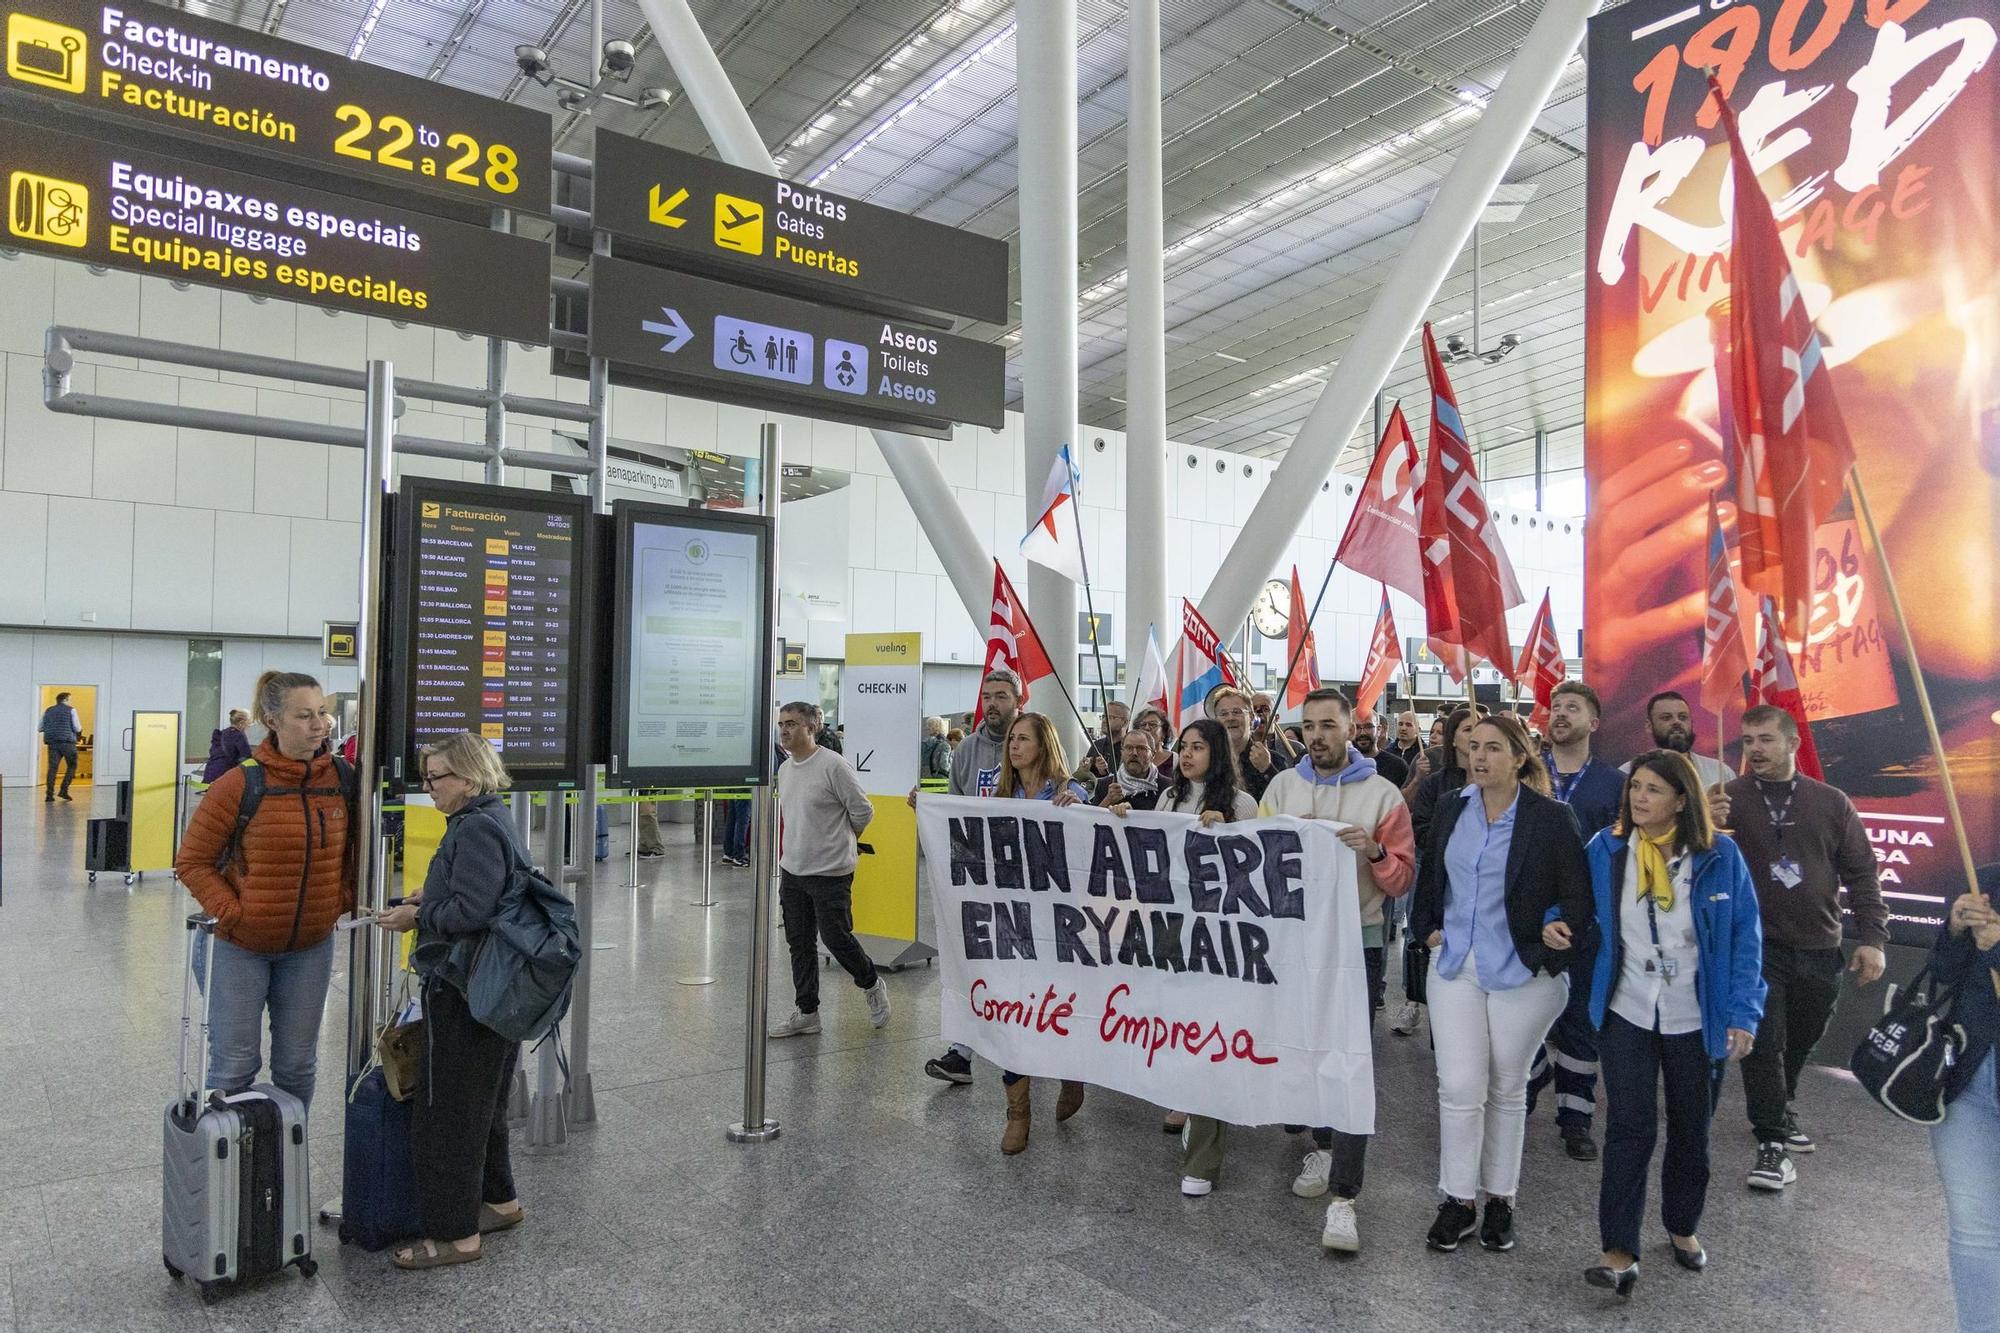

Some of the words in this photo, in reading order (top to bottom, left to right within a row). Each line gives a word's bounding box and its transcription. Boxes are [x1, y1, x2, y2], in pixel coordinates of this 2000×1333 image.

[101, 6, 330, 92] Facturamento
[102, 41, 211, 91] Check-in
[1633, 0, 1930, 146] 190
[101, 71, 296, 142] Facturación
[334, 105, 413, 171] 22
[418, 124, 440, 148] to
[1597, 17, 1998, 286] RED
[420, 157, 437, 177] a
[445, 133, 519, 194] 28
[112, 162, 279, 222] Equipaxes
[286, 204, 421, 252] especiais
[777, 182, 847, 222] Portas
[112, 196, 204, 236] Special
[211, 219, 307, 257] luggage
[777, 212, 824, 240] Gates
[1640, 164, 1933, 314] VINAGE
[110, 225, 269, 280] Equipajes
[276, 263, 428, 309] especiales
[776, 236, 859, 277] Puertas
[880, 325, 938, 356] Aseos
[881, 351, 929, 376] Toilets
[878, 376, 936, 405] Aseos
[607, 465, 675, 490] aenaparking.com
[445, 508, 507, 522] Facturación
[536, 532, 572, 541] Mostradores
[875, 643, 906, 655] vueling
[1087, 616, 1101, 641] 7
[1418, 642, 1427, 661] 4
[857, 683, 907, 694] CHECK-IN
[948, 816, 1071, 893] NON
[1087, 822, 1175, 905] AO
[1184, 829, 1305, 921] ERE
[961, 900, 1037, 960] EN
[1053, 902, 1278, 985] RYANAIR
[970, 978, 1076, 1036] Comité
[1100, 983, 1278, 1068] Empresa
